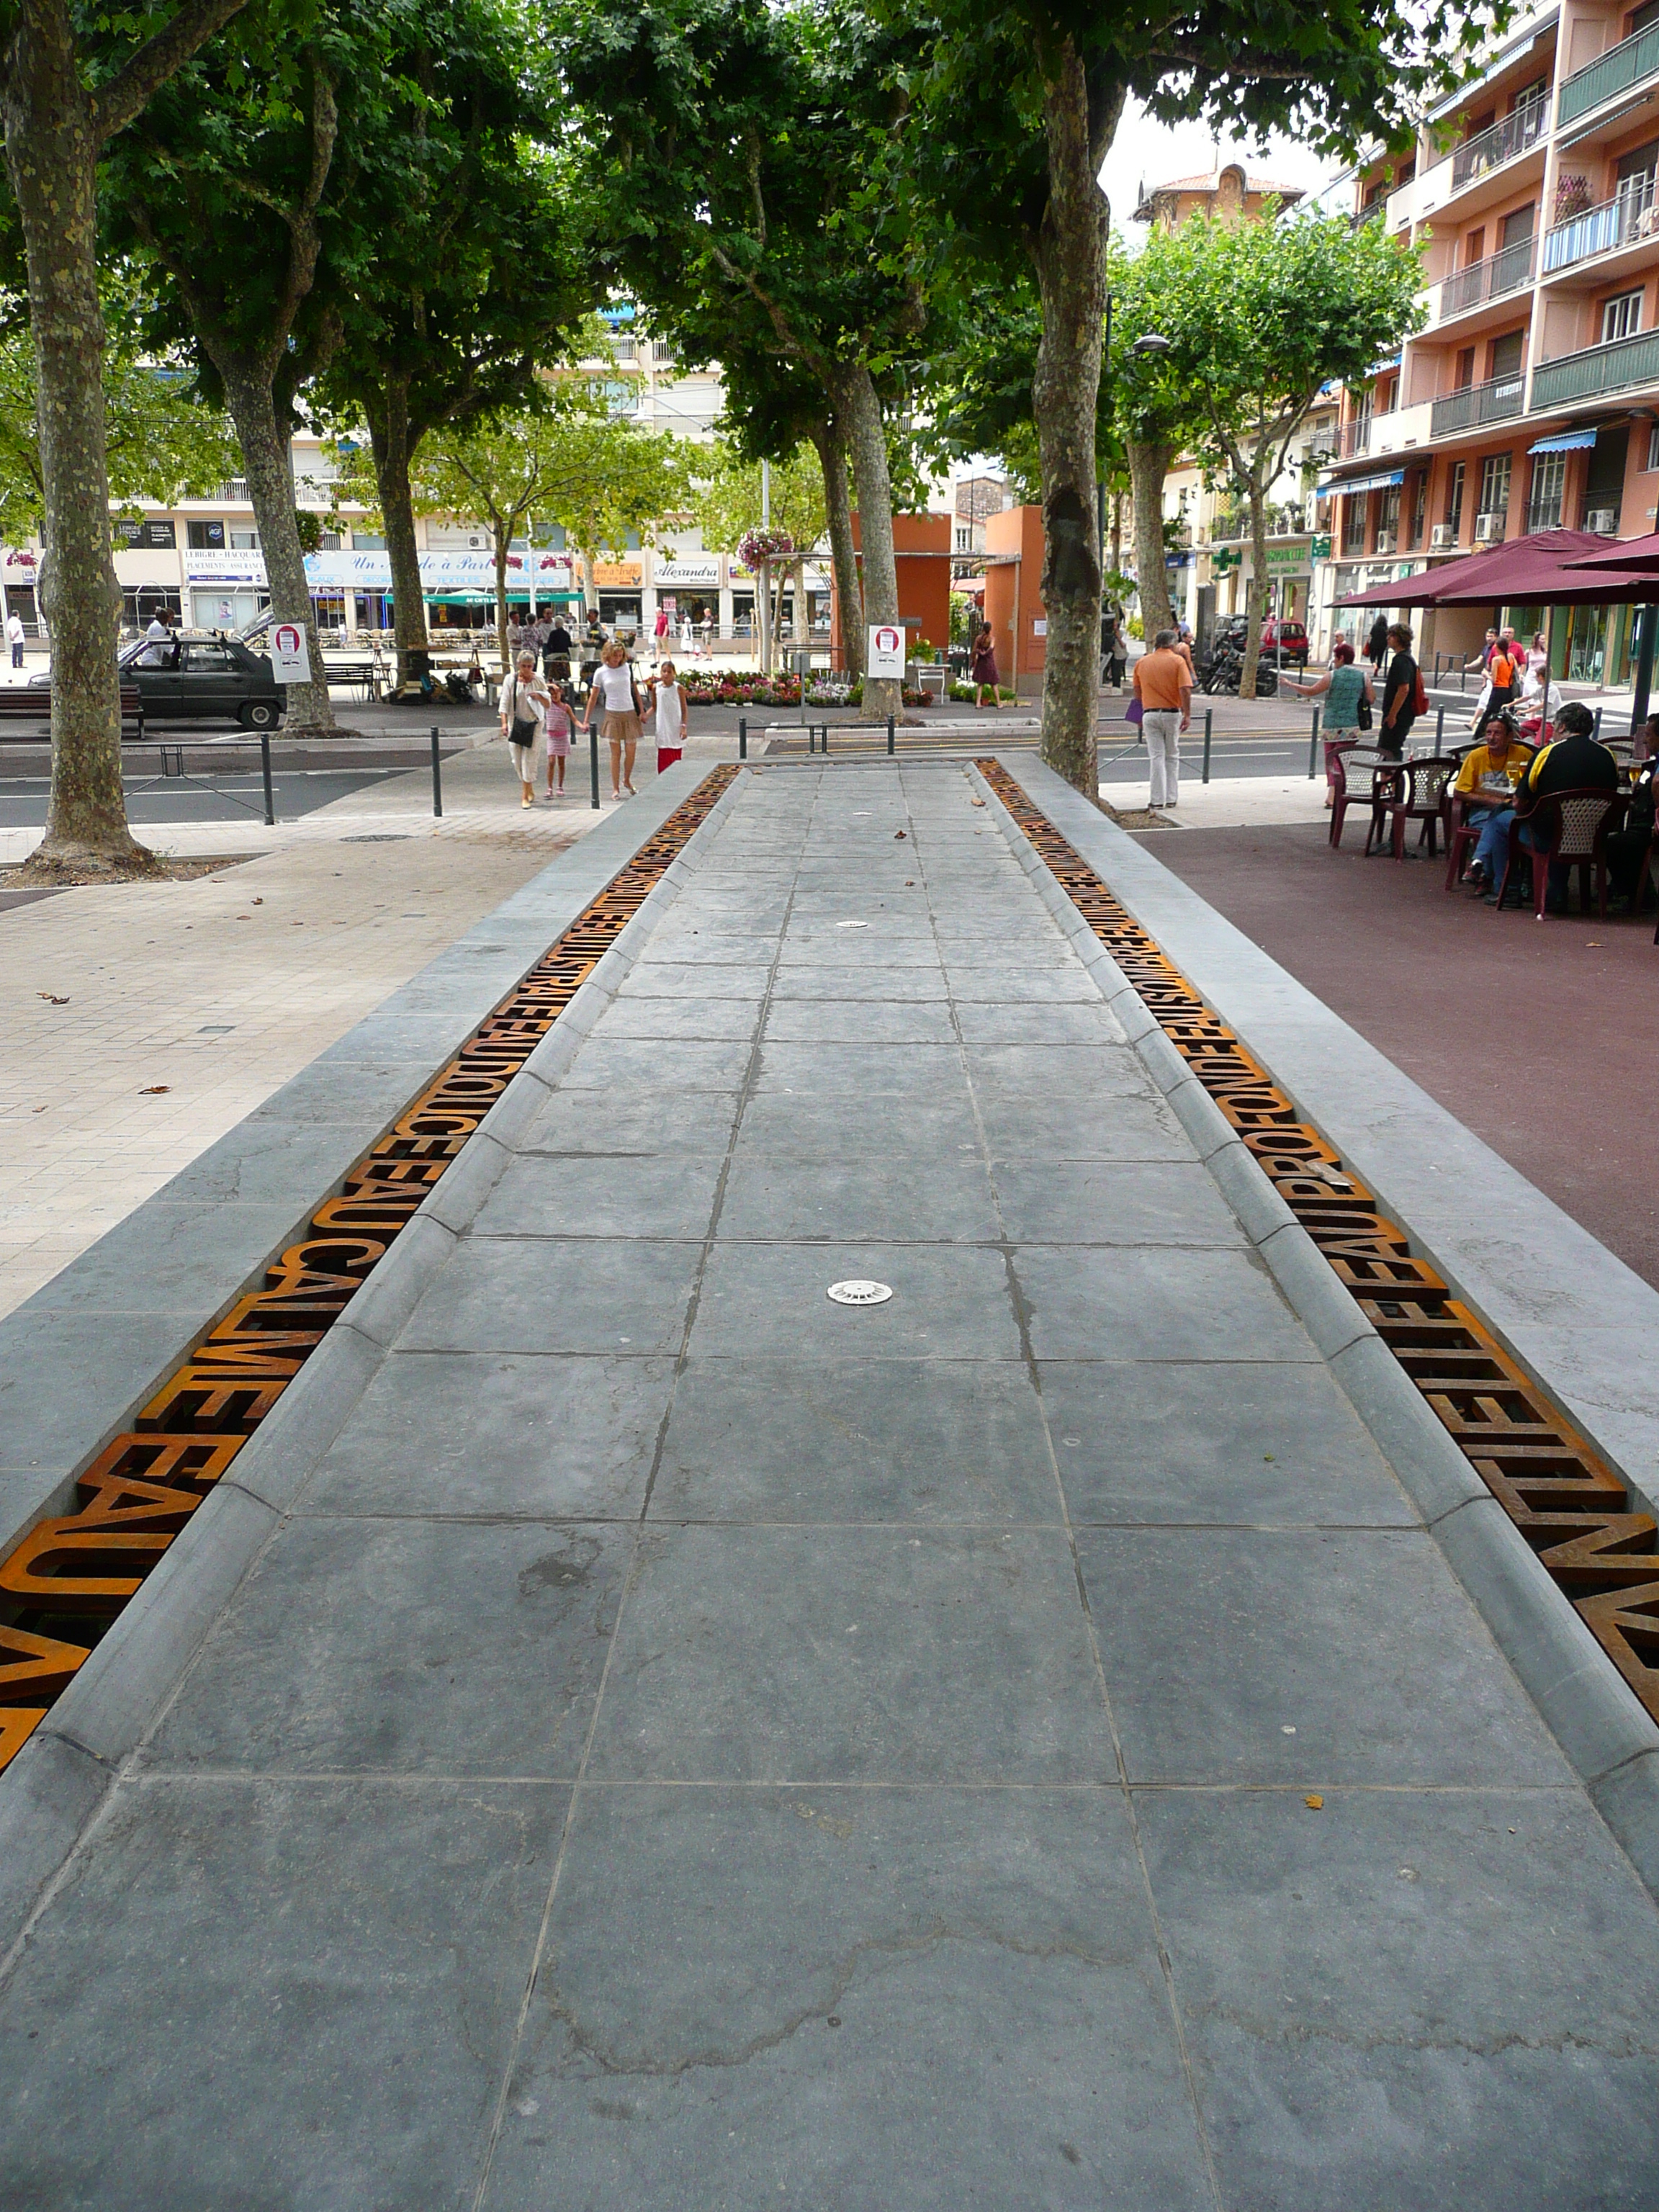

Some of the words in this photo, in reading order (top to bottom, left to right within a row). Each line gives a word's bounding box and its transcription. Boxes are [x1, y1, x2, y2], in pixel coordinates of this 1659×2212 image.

[225, 551, 262, 560] HACQUAR
[351, 556, 374, 570] Un
[456, 555, 493, 570] Part
[654, 564, 716, 578] Alexandra
[629, 852, 679, 866] EAU
[1048, 868, 1102, 883] EAU
[580, 867, 667, 920] CRISTALLINE
[1062, 883, 1130, 918] INFINIE
[560, 921, 629, 943] EAU
[1086, 918, 1146, 938] EAU
[493, 945, 609, 1016] LUSTRALE
[1105, 940, 1204, 1004] SOMBRE
[456, 1018, 555, 1058] EAU
[1148, 1005, 1237, 1043] EAU
[371, 1061, 523, 1154] DOUCE
[1175, 1044, 1377, 1204] PROFONDE
[311, 1159, 454, 1230] EAU
[1293, 1210, 1449, 1290] EAU
[137, 1237, 387, 1422] CALME
[0, 1433, 248, 1595] EAU
